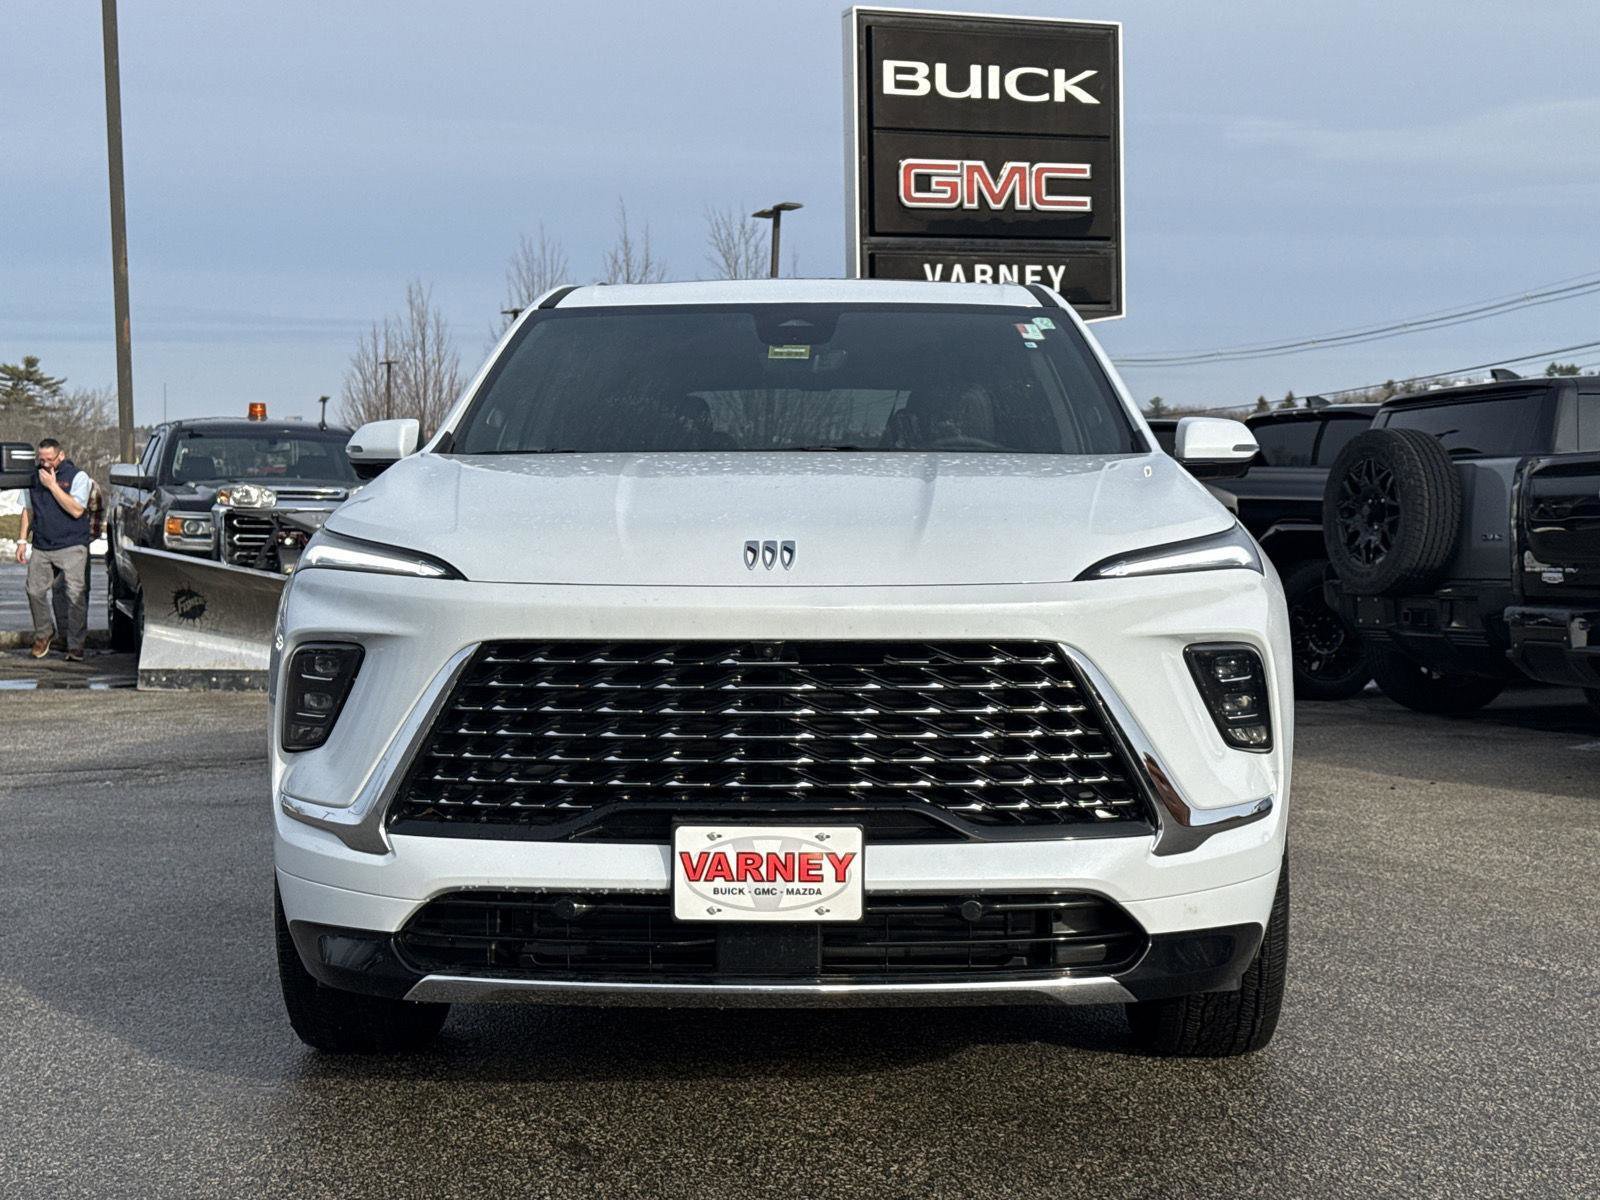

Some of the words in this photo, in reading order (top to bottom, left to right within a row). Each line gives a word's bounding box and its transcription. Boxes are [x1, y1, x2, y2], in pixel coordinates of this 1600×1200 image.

[882, 59, 1101, 105] BUICK
[898, 158, 1092, 212] GMC
[923, 263, 1066, 293] VARNEY
[679, 851, 857, 883] VARNEY
[713, 887, 746, 896] BUICK
[754, 887, 778, 896] GMC
[786, 887, 823, 896] MAZDA
